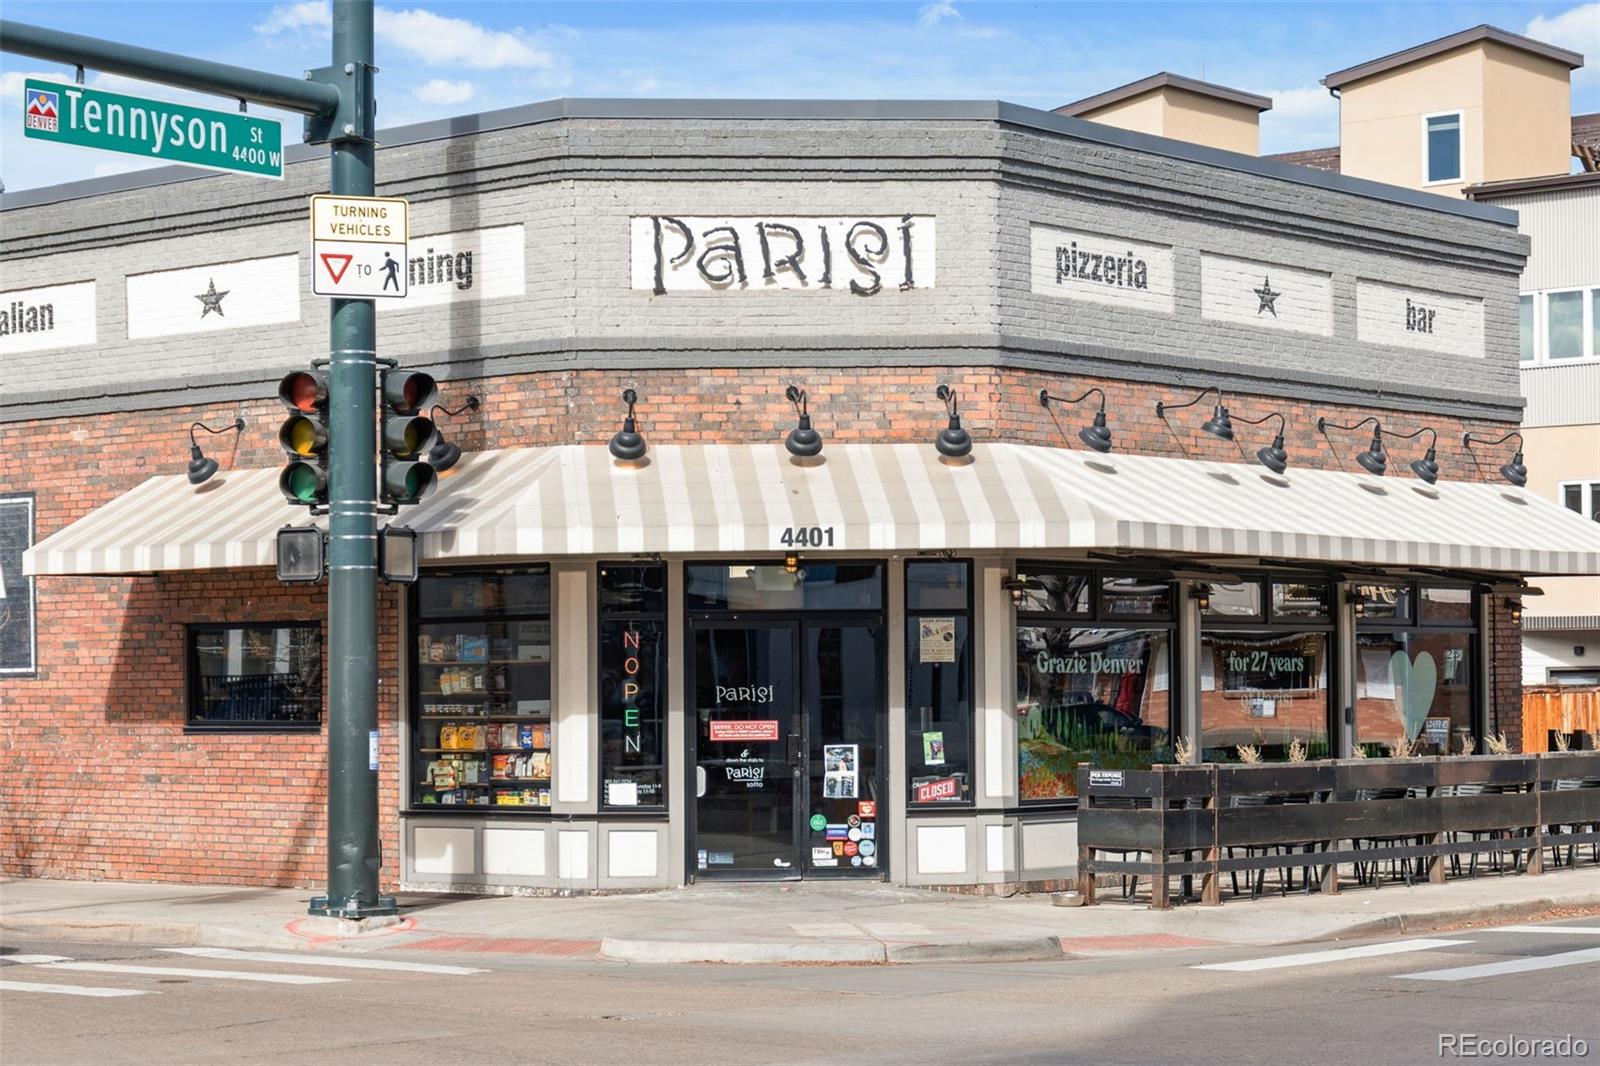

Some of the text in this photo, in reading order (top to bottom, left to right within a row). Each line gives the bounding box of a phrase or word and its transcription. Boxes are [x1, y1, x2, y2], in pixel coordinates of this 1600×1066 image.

[27, 115, 58, 131] DENVER
[65, 90, 263, 153] Tennyson St
[232, 146, 281, 168] 4400 W
[333, 205, 387, 219] TURNING
[330, 223, 391, 237] VEHICLES
[356, 264, 372, 276] TO
[1055, 241, 1148, 290] pizzeria
[1405, 297, 1436, 335] bar
[781, 527, 833, 547] 4401
[1036, 650, 1143, 674] Grazie Denver
[1226, 650, 1304, 677] for 27 years
[919, 781, 954, 800] CLOSED
